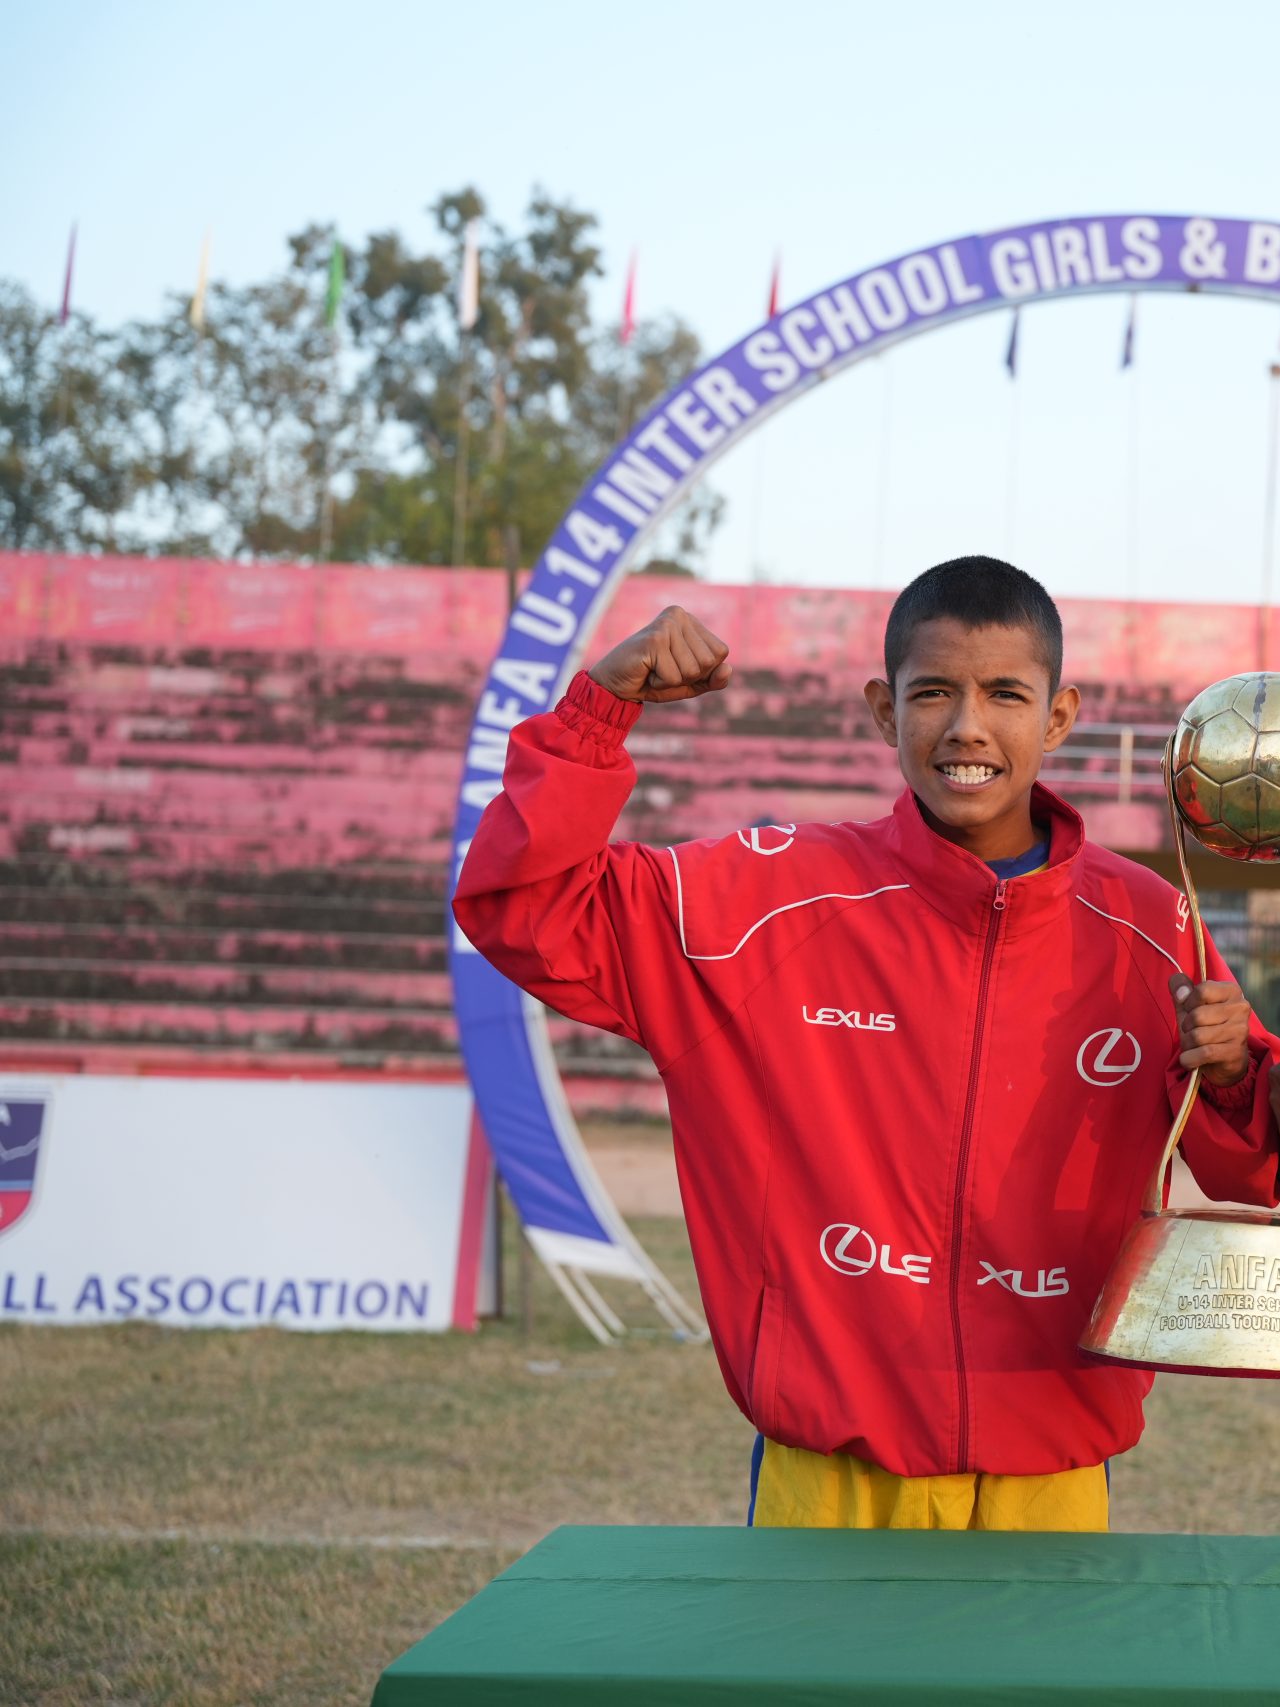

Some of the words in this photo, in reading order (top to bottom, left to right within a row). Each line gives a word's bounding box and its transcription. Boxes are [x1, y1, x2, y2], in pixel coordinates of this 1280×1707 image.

[511, 509, 626, 647] U-14
[592, 365, 758, 531] INTER
[744, 244, 982, 393] SCHOOL
[990, 217, 1164, 298] GIRLS
[1179, 217, 1227, 279] &
[802, 1005, 896, 1032] LEXUS
[976, 1260, 1070, 1298] XUS
[74, 1275, 430, 1319] ASSOCIATION
[1178, 1295, 1210, 1311] U-14
[1212, 1294, 1254, 1310] INTER
[1159, 1314, 1230, 1331] FOOTBALL
